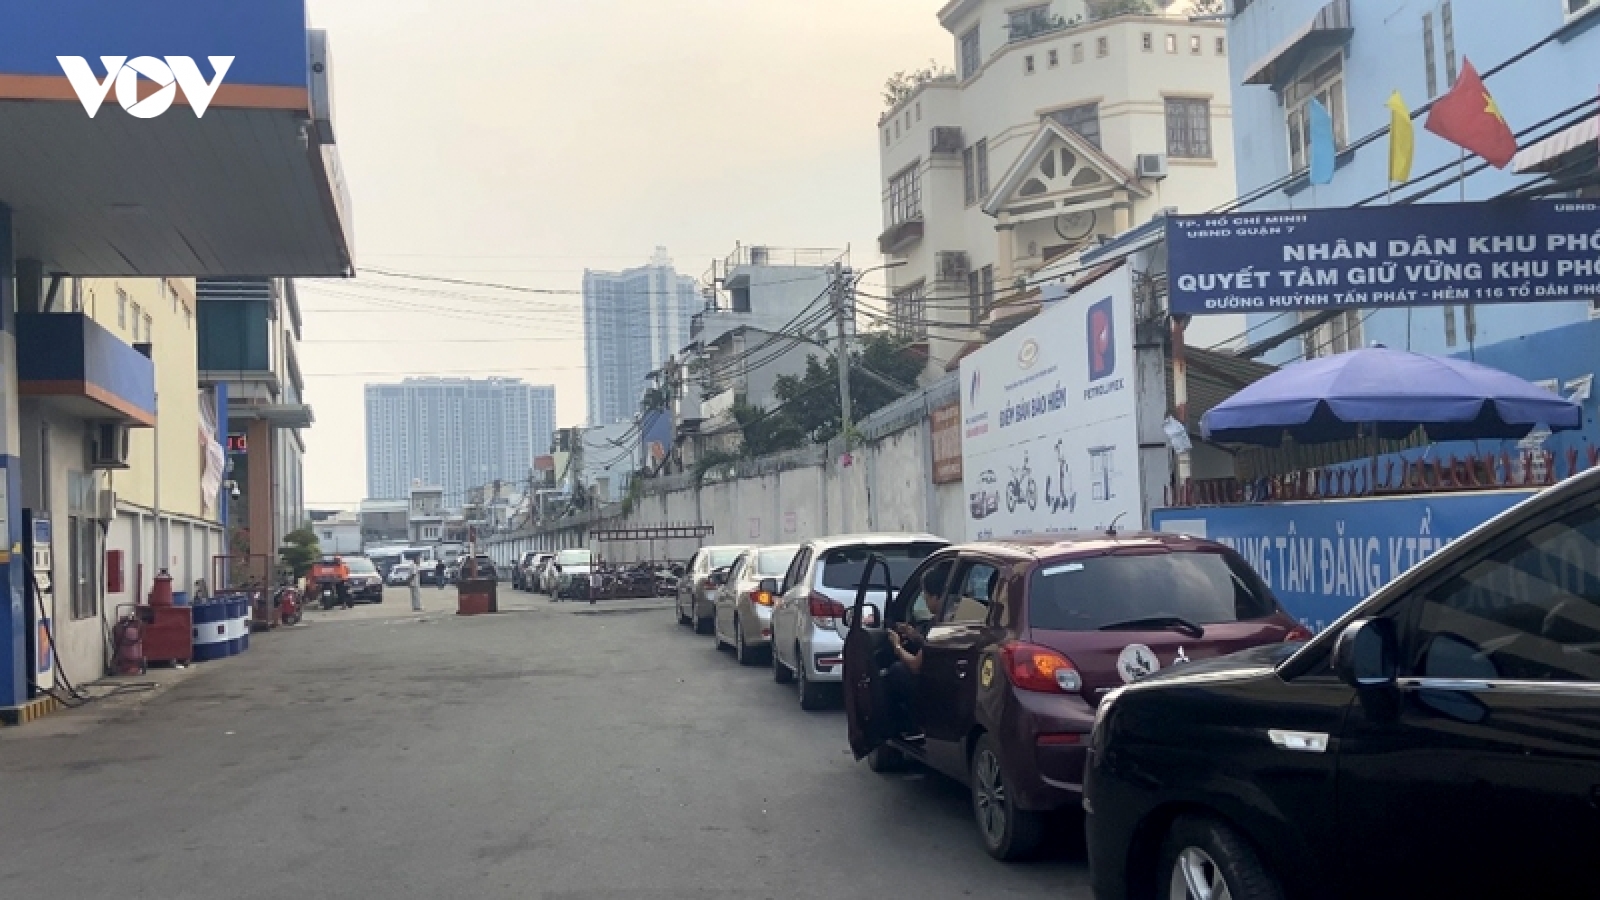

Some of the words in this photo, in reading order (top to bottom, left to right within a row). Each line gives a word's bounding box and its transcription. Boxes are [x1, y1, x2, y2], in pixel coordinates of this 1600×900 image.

[1176, 219, 1200, 228] TP.
[1205, 215, 1229, 226] HỒ
[1232, 216, 1261, 225] CHÍ
[1265, 214, 1306, 223] MINH
[1187, 229, 1231, 238] UBND
[1236, 227, 1280, 236] QUẬN
[1283, 238, 1377, 262] NHÂN
[1388, 234, 1457, 257] DÂN
[1468, 235, 1537, 254] KHU
[1177, 265, 1271, 292] QUYẾT
[1278, 266, 1338, 288] TÂM
[1347, 260, 1397, 284] GIỮ
[1404, 259, 1482, 282] VỮNG
[1491, 261, 1549, 279] KHU
[1204, 294, 1265, 309] ĐƯỜNG
[1269, 291, 1329, 306] HUỲNH
[1333, 288, 1368, 303] TẤN
[1372, 288, 1418, 303] PHÁT
[1475, 287, 1503, 298] 116
[1535, 282, 1569, 297] DÂN
[1275, 520, 1314, 594] TÂM
[1320, 520, 1381, 597] ĐĂNG
